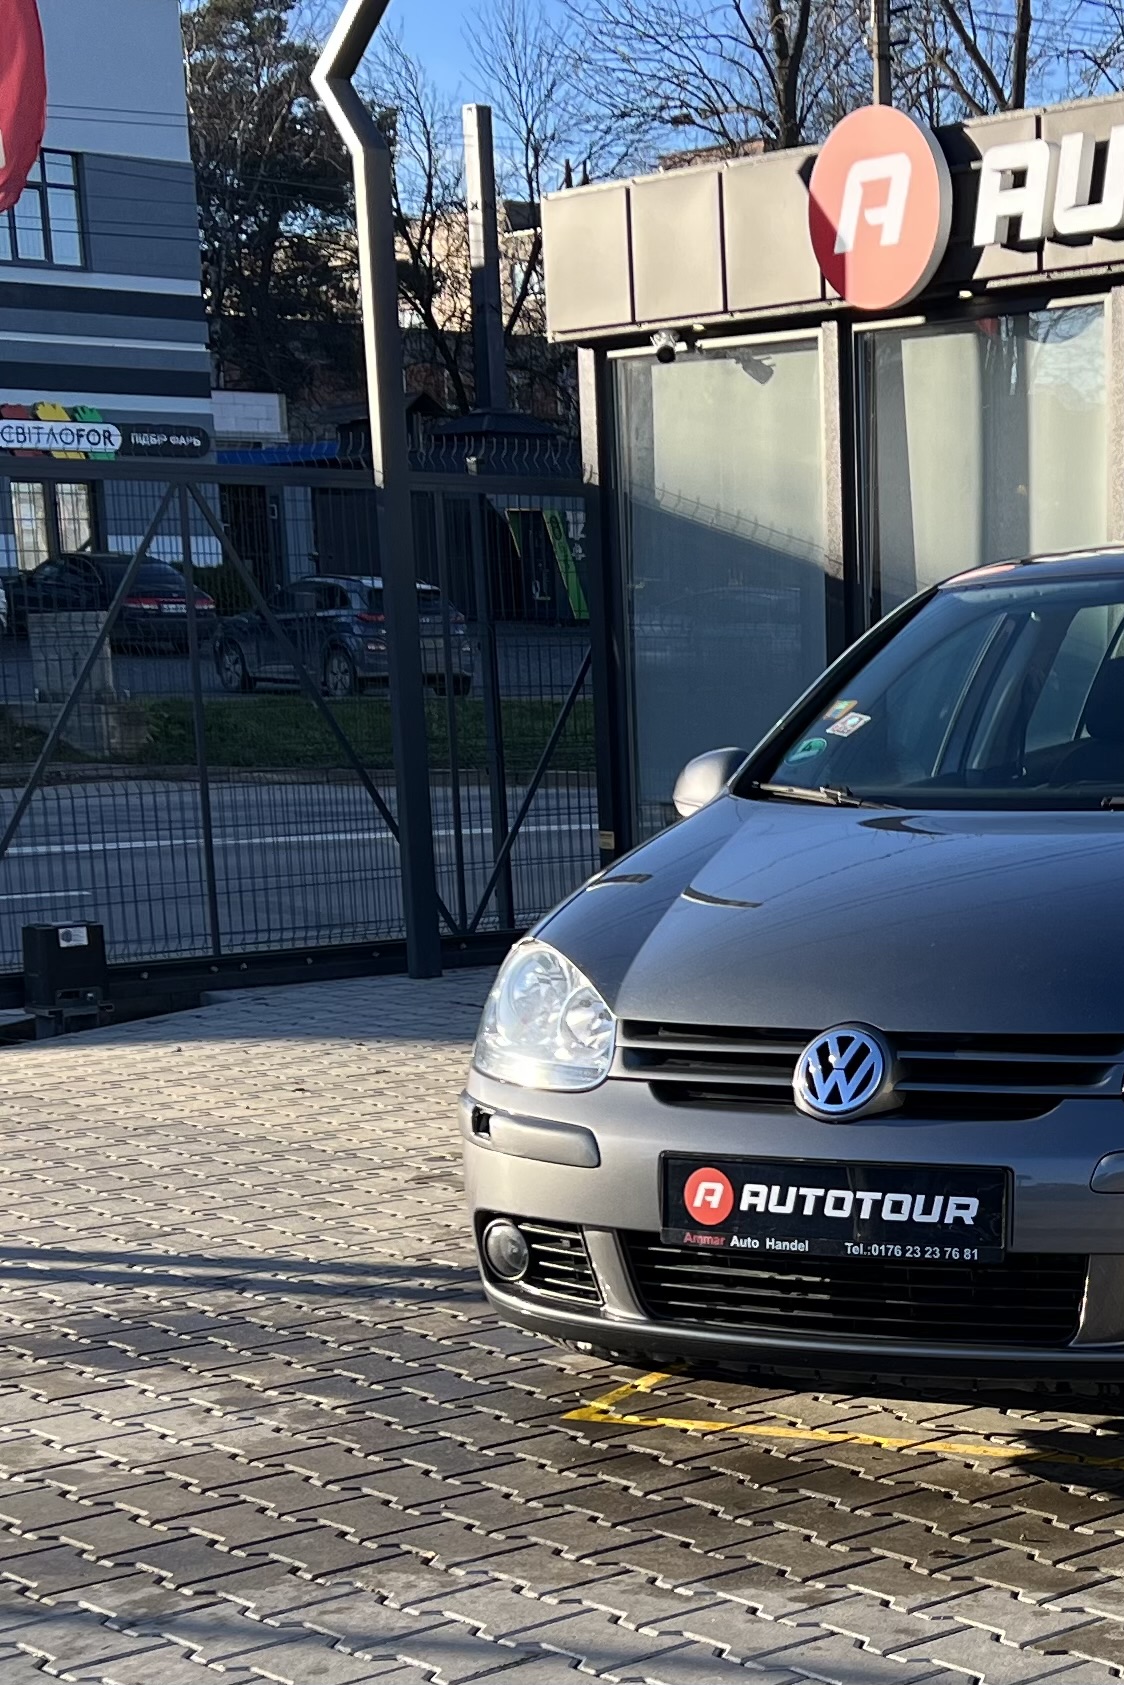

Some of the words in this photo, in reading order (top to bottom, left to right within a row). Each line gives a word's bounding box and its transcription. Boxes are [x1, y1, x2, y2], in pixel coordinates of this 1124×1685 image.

[834, 152, 912, 255] A
[693, 1181, 724, 1208] A
[740, 1184, 979, 1224] AUTOTOUR
[683, 1232, 725, 1246] Ammar
[730, 1235, 760, 1249] Auto
[766, 1238, 809, 1252] Handel
[905, 1245, 921, 1258] 23
[924, 1247, 940, 1259] 23
[944, 1247, 960, 1260] 76
[963, 1248, 979, 1261] 81
